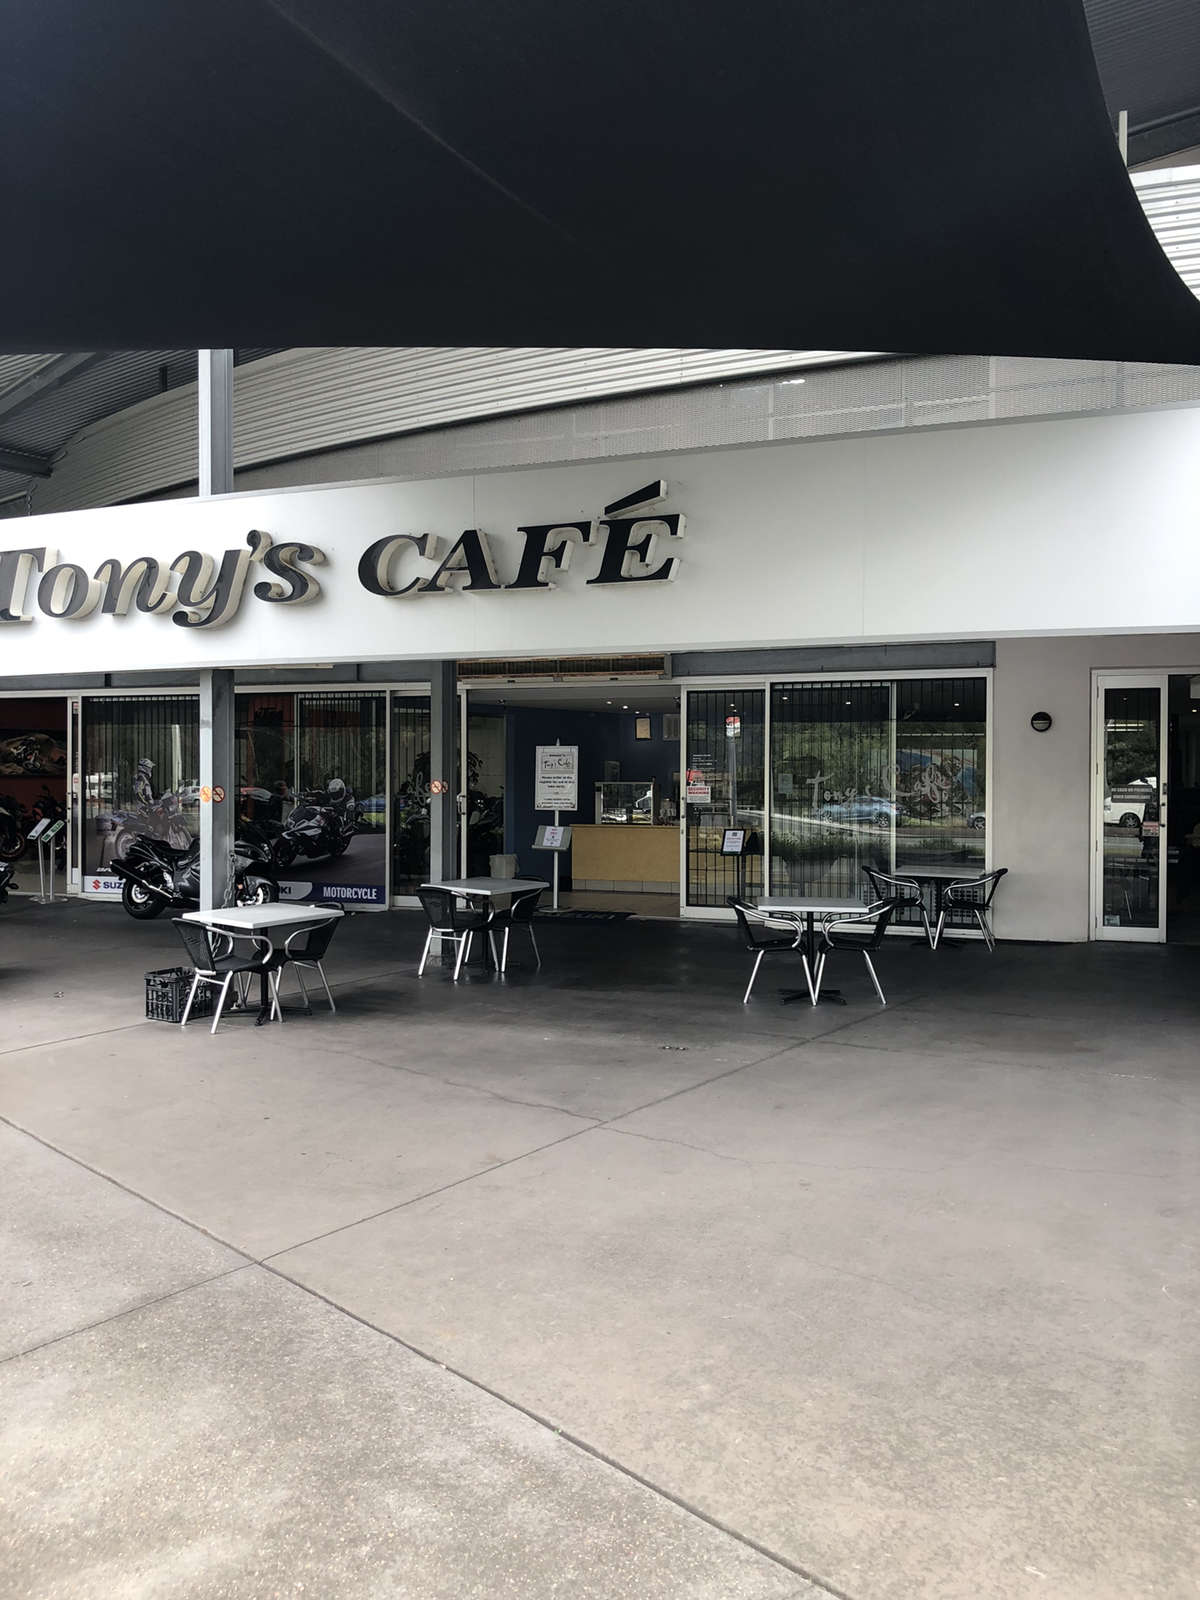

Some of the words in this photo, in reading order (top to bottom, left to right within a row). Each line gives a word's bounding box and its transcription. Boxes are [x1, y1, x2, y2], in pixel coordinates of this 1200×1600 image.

[0, 529, 328, 631] Tony's
[357, 480, 687, 598] CAFÉ
[102, 881, 123, 890] SUZ
[323, 886, 377, 900] MOTORCYCLE
